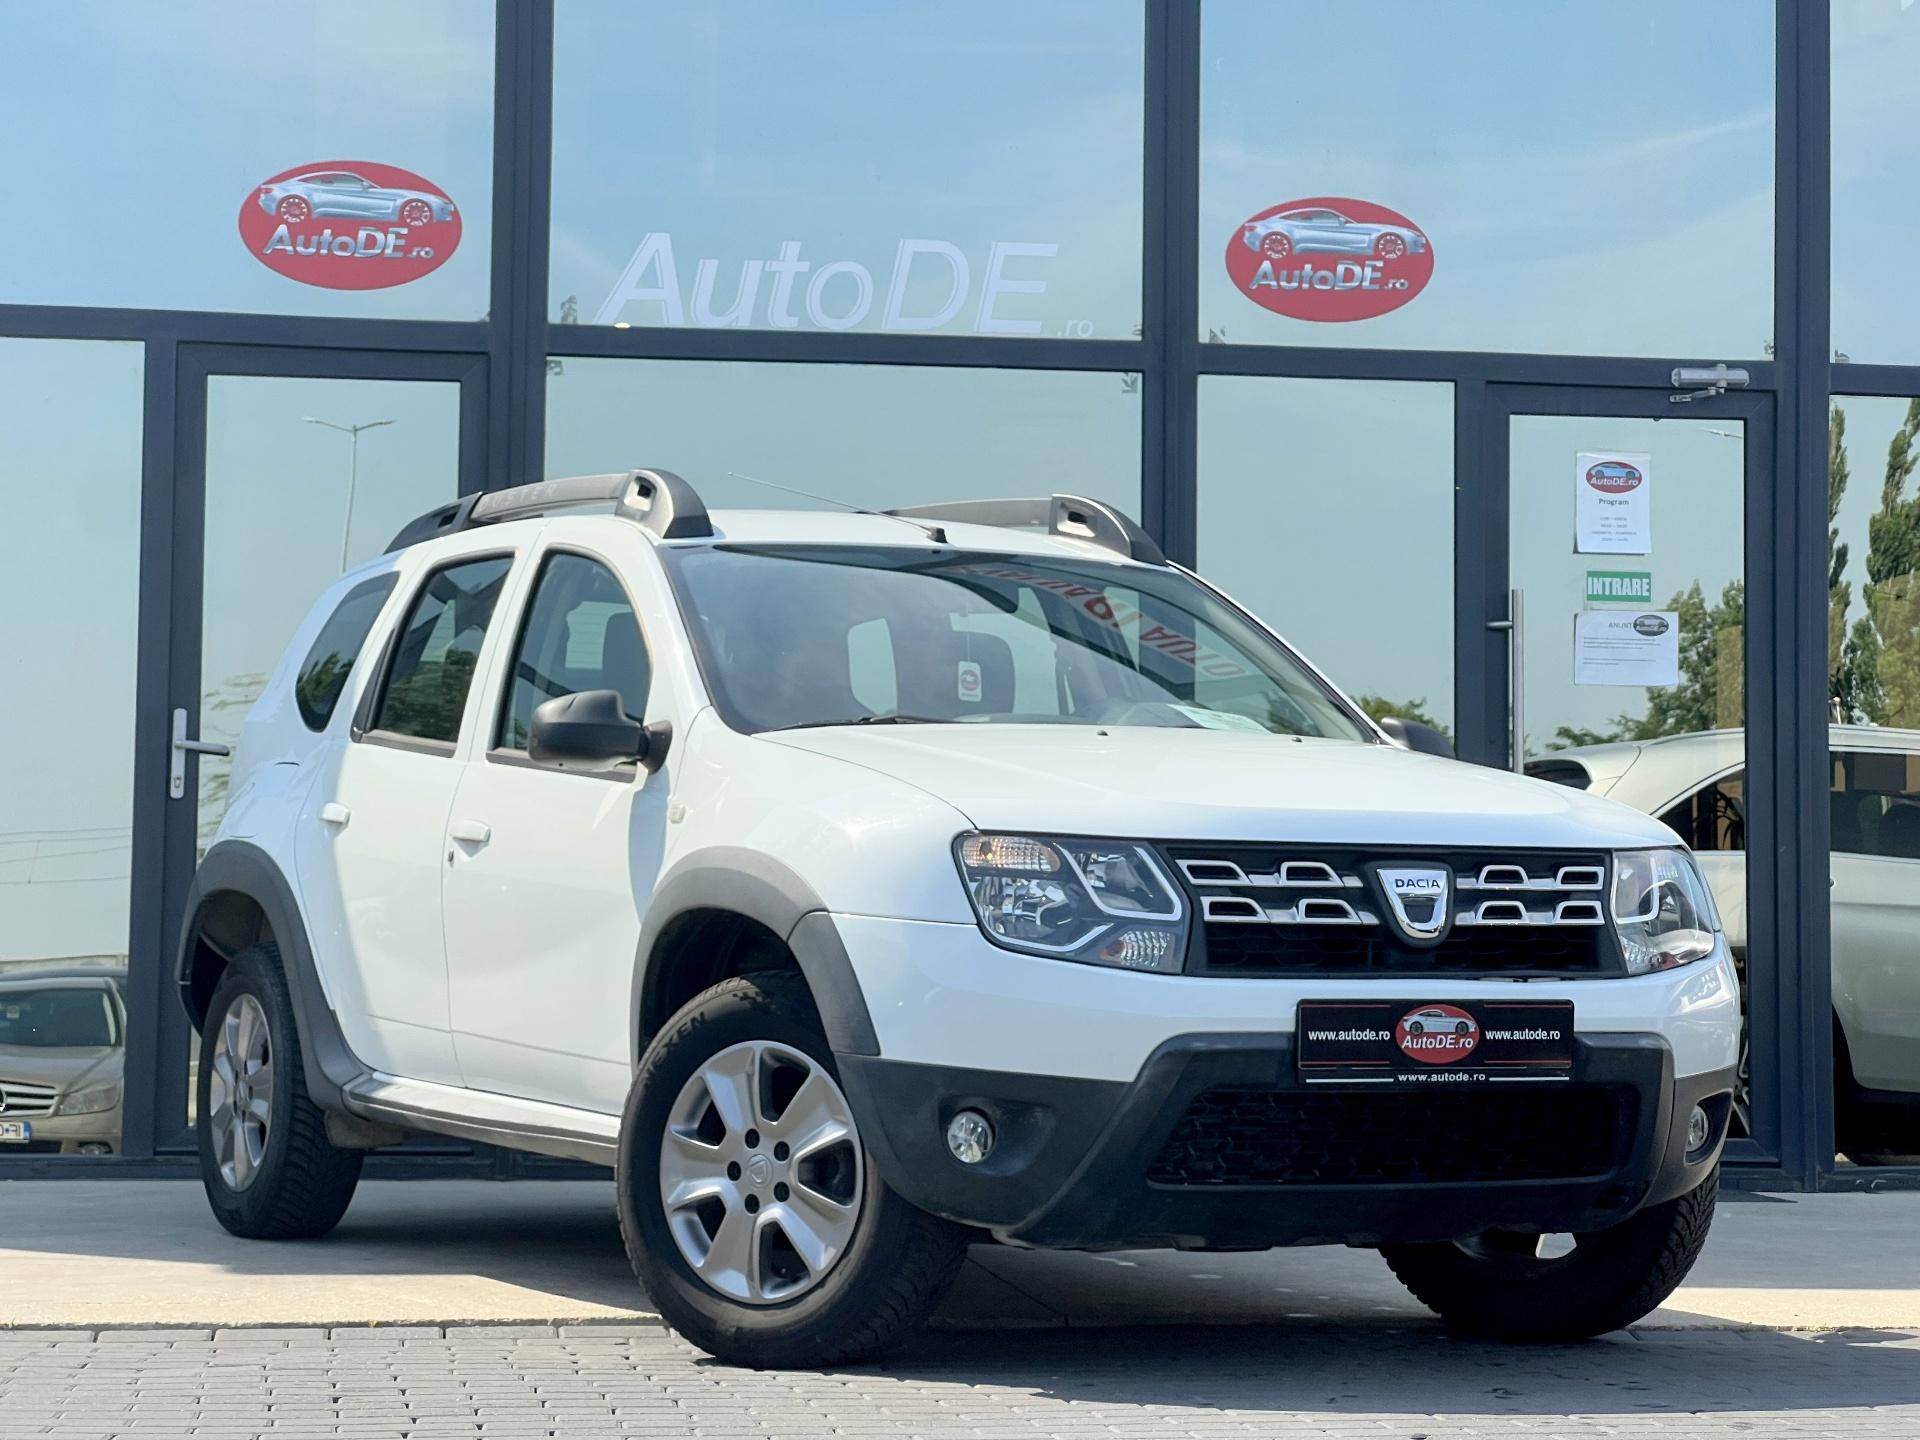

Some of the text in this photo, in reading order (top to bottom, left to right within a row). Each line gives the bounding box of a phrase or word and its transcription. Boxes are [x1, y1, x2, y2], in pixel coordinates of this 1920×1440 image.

[1590, 476, 1639, 486] AutoDE.ro
[1598, 498, 1629, 506] Program
[1587, 577, 1650, 596] INTRARE
[1394, 878, 1441, 889] DACIA
[1308, 1028, 1391, 1041] www.autode.ro
[1485, 1028, 1561, 1041] www.autode.ro
[1402, 1035, 1474, 1050] AutoDE.ro
[1398, 1071, 1486, 1082] www.autode.ro
